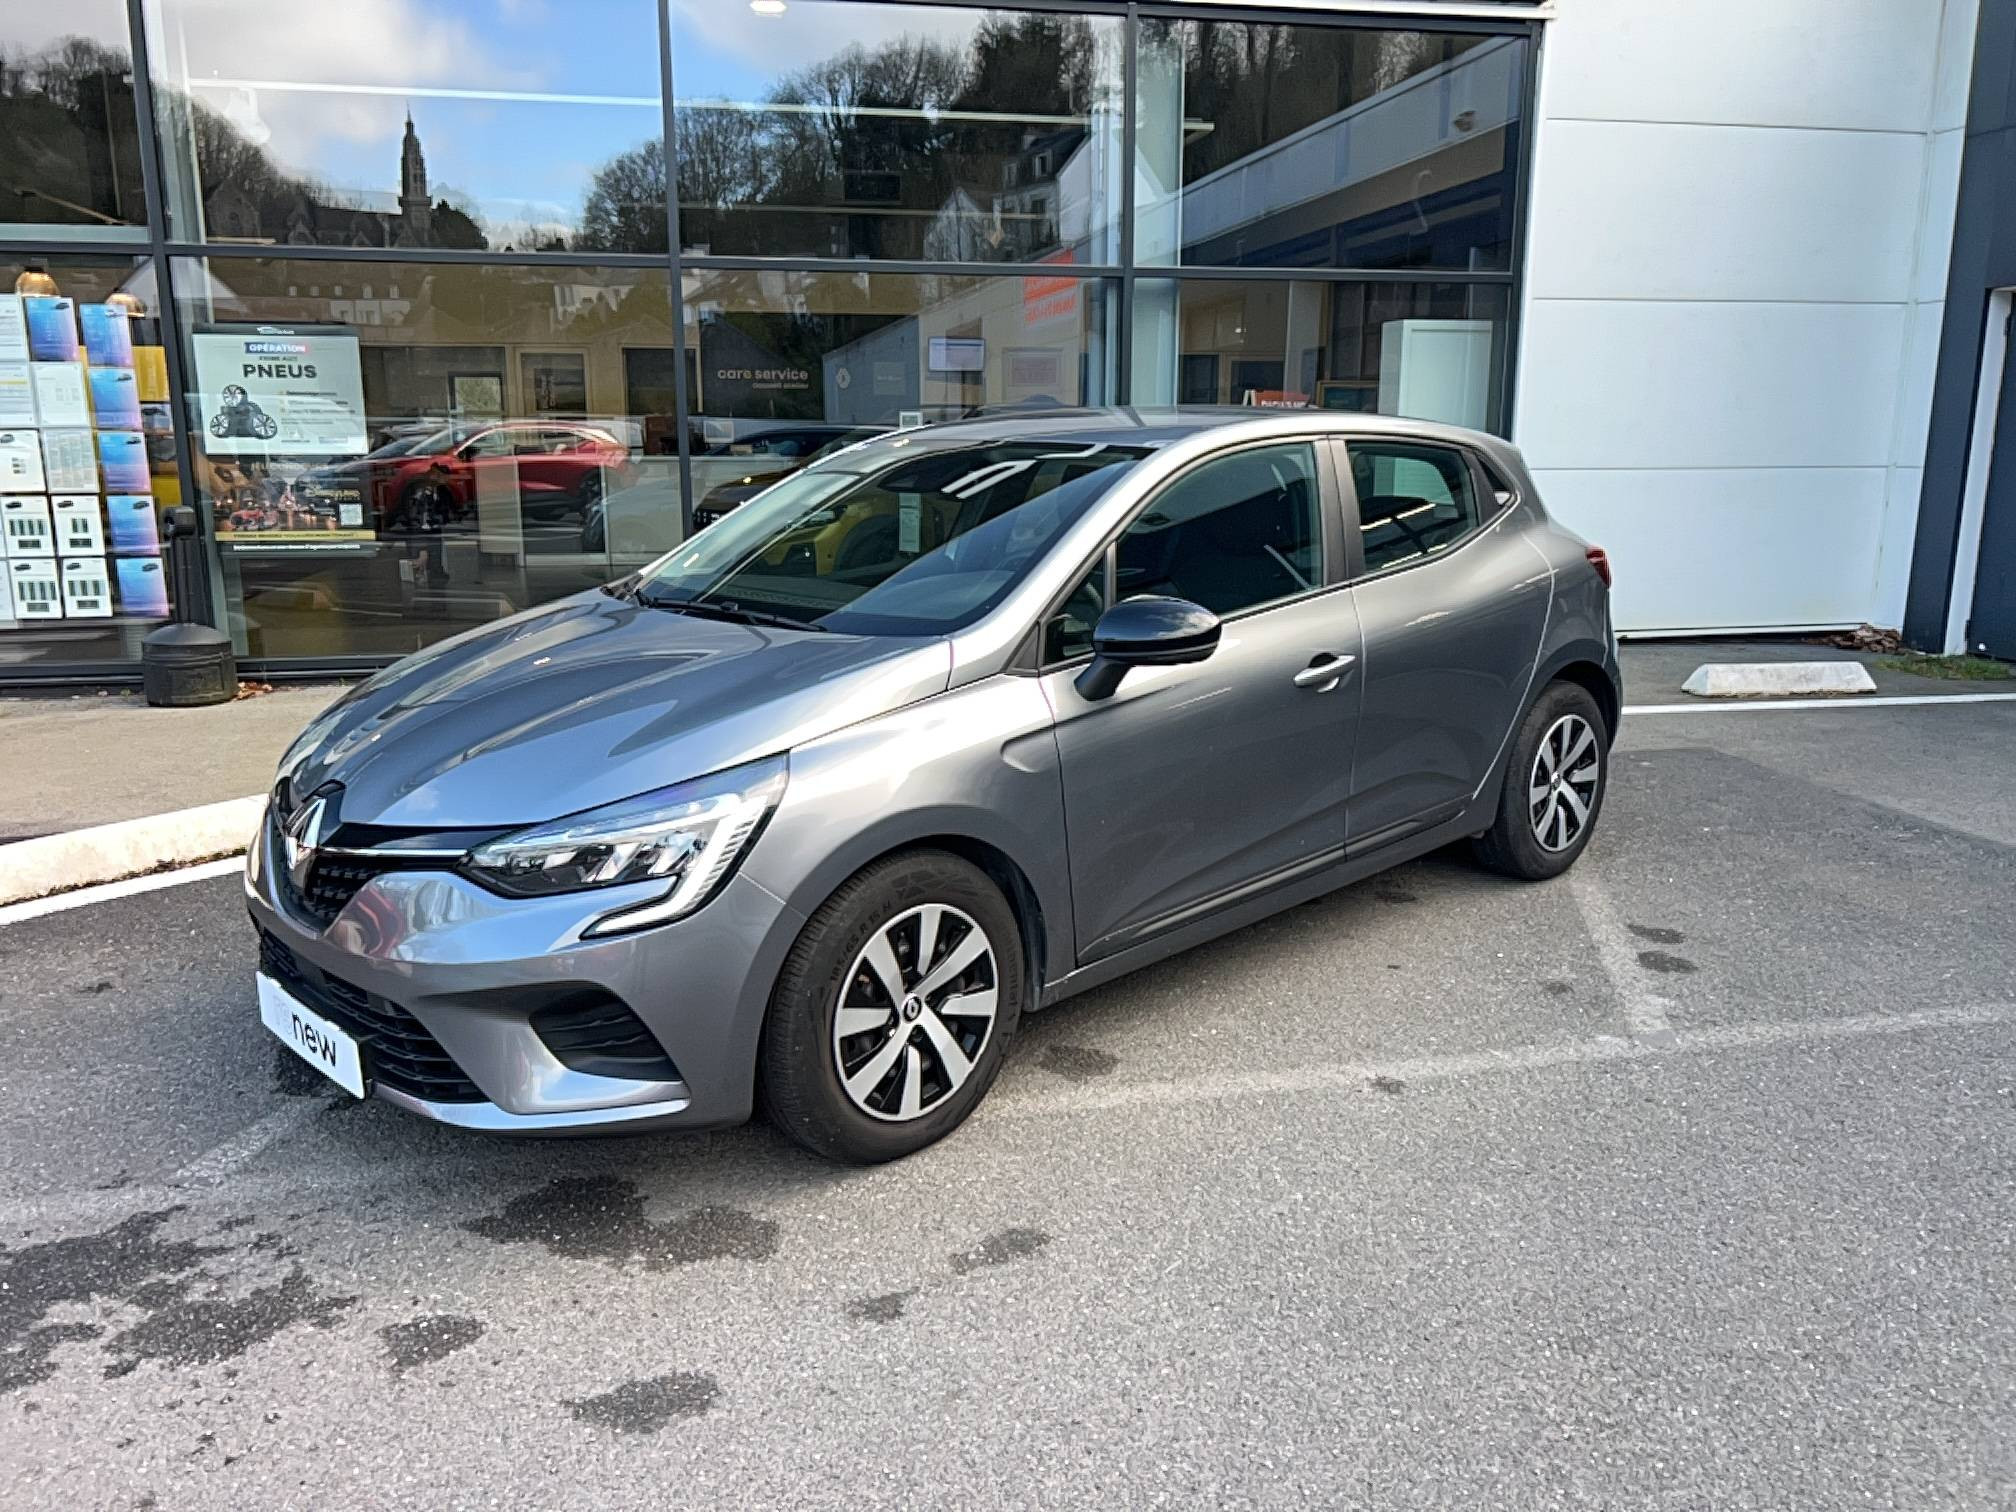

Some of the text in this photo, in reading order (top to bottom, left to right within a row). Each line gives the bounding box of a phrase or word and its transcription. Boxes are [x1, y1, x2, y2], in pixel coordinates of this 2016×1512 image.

[249, 342, 306, 353] OPÉRATION
[243, 364, 317, 379] PNEUS
[717, 367, 809, 380] care service
